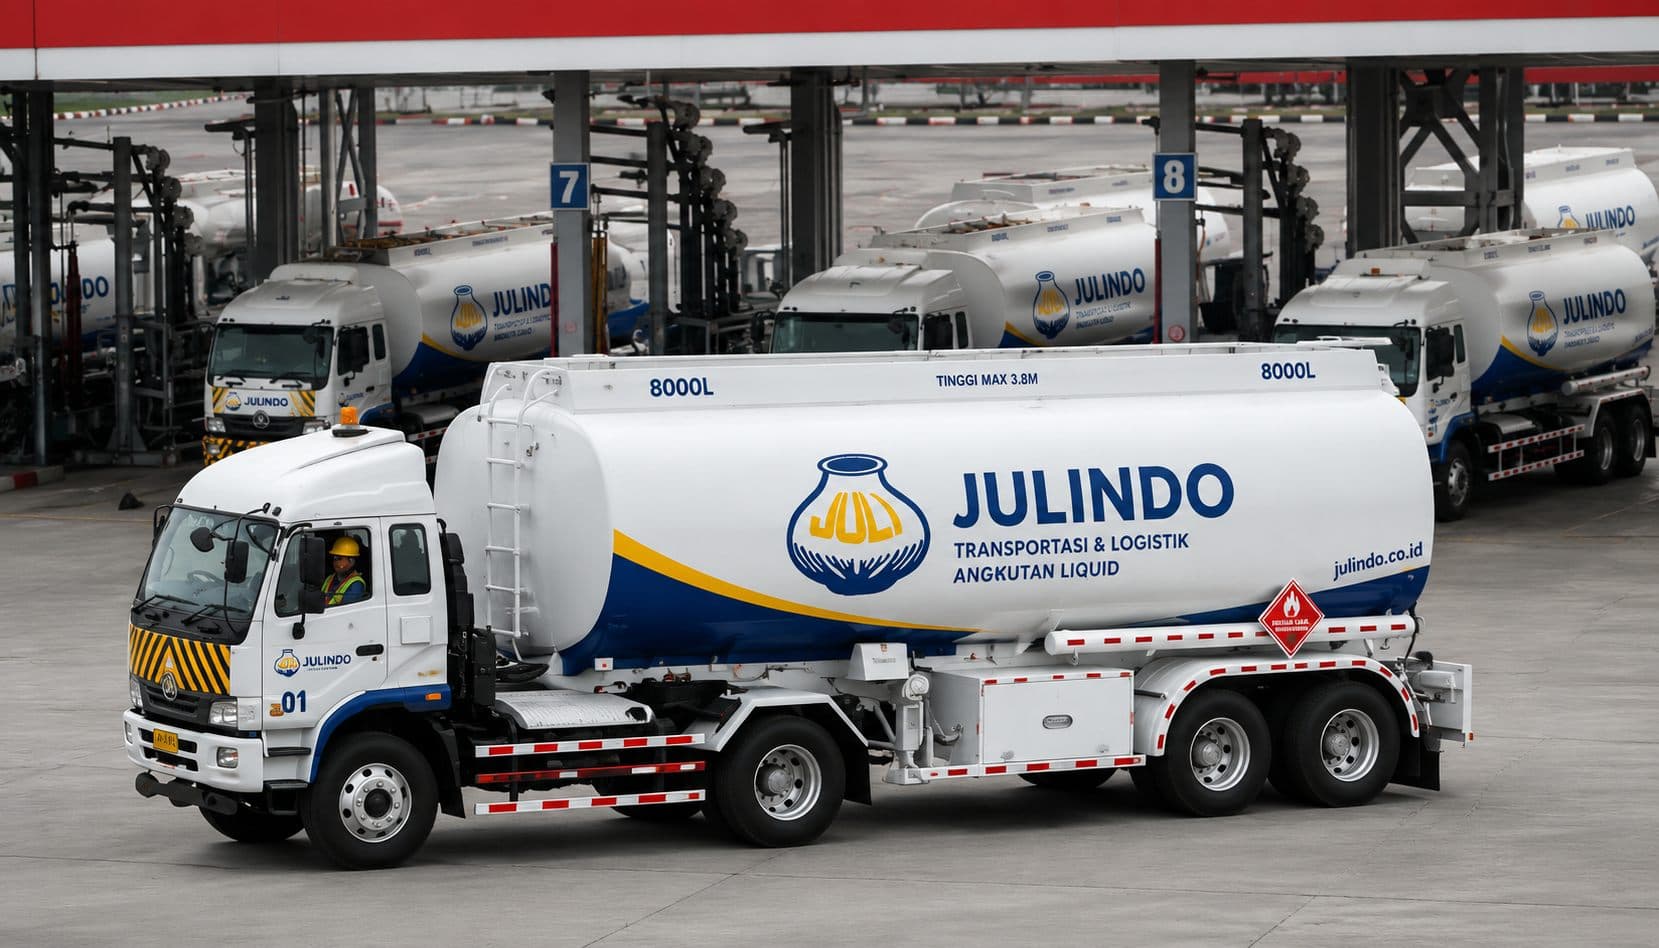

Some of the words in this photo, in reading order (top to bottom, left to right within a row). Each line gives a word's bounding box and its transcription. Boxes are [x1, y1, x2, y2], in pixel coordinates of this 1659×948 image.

[559, 171, 579, 203] 7
[1163, 160, 1186, 193] 8
[493, 283, 551, 317] JULIND
[1075, 268, 1145, 305] JULINDO
[1563, 288, 1626, 324] JULINDO
[936, 374, 978, 388] TINGGI
[981, 373, 1008, 388] MAX
[1011, 372, 1038, 386] 3.8M
[1261, 362, 1316, 380] 8000L
[650, 377, 714, 398] 8000L
[244, 397, 289, 408] JULINDO
[953, 462, 1235, 529] JULINDO
[809, 491, 903, 544] JULI
[954, 536, 1088, 558] TRANSPORTASI
[1093, 536, 1106, 553] &
[1111, 532, 1190, 552] LOGISTIK
[953, 564, 1055, 584] ANGKUTAN
[1060, 560, 1120, 580] LIQUID
[1334, 541, 1423, 581] julindo.co.id
[302, 654, 352, 667] JULINDO
[282, 690, 306, 713] 01
